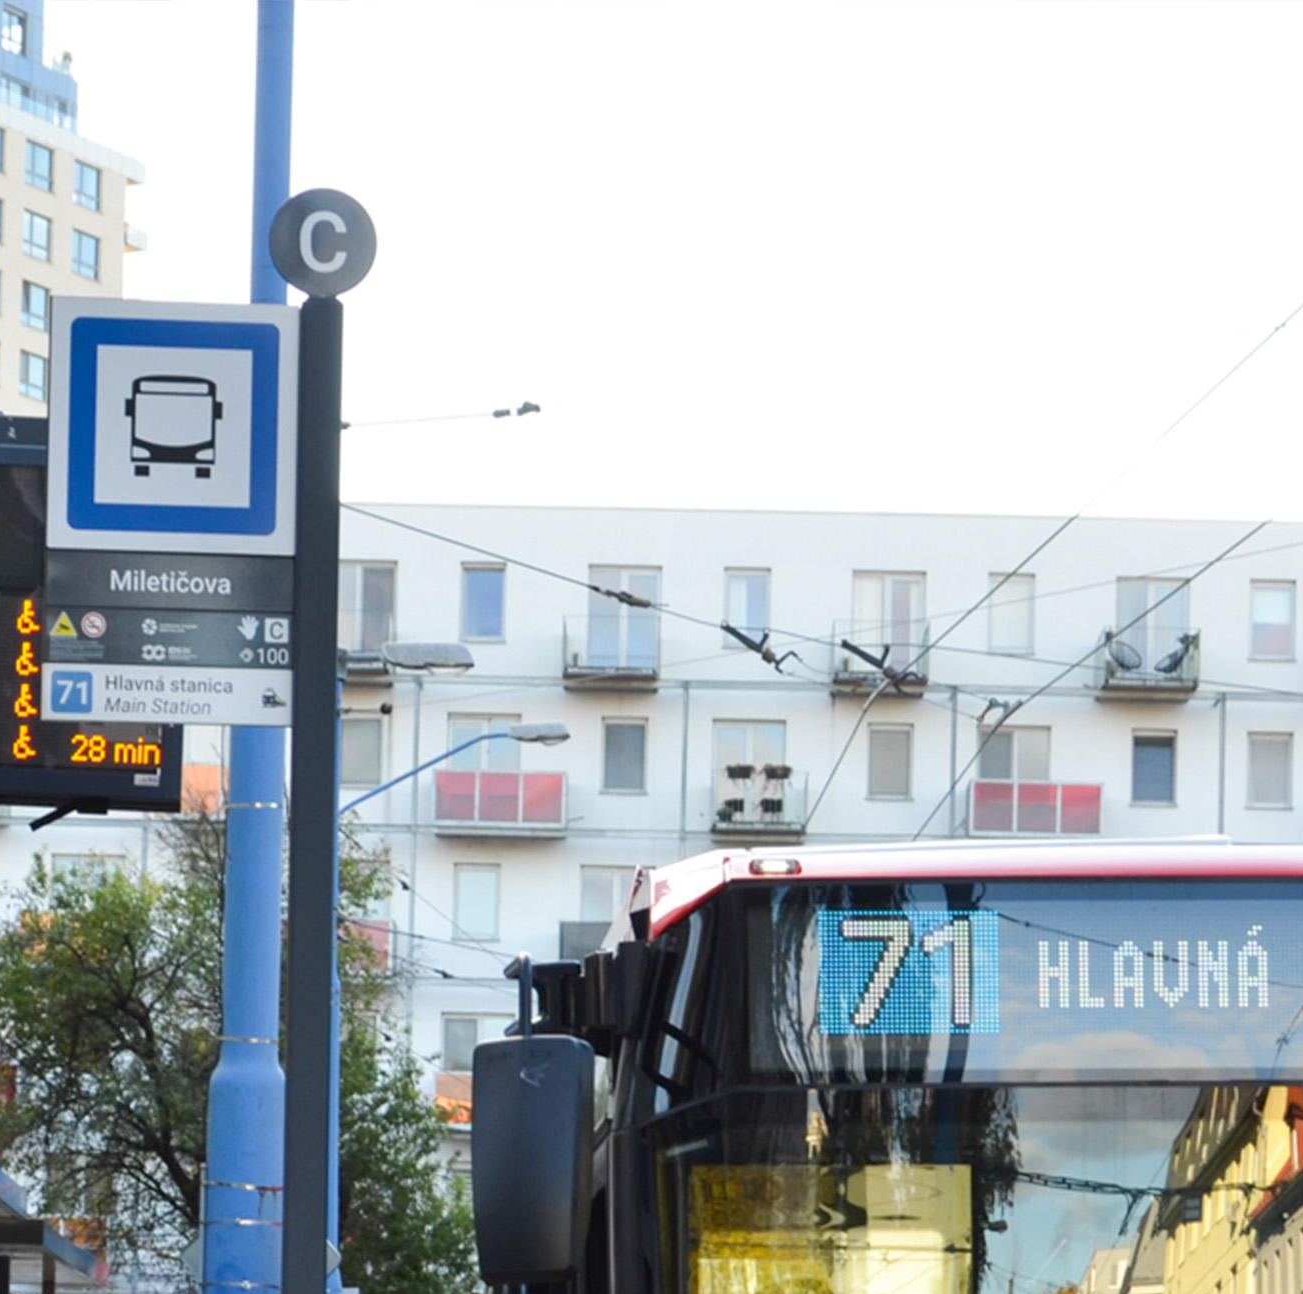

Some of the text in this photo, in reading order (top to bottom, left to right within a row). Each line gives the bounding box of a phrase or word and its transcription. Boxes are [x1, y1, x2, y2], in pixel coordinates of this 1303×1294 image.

[300, 210, 347, 273] C
[110, 569, 232, 595] Miletičova
[269, 622, 284, 640] C
[257, 648, 289, 665] 100
[56, 679, 89, 705] 71
[104, 674, 234, 695] Hlavná stanica
[104, 697, 212, 715] Main Station
[70, 734, 161, 765] 28 min
[841, 919, 971, 1027] 71
[1037, 925, 1269, 1008] HLAVNÁ
